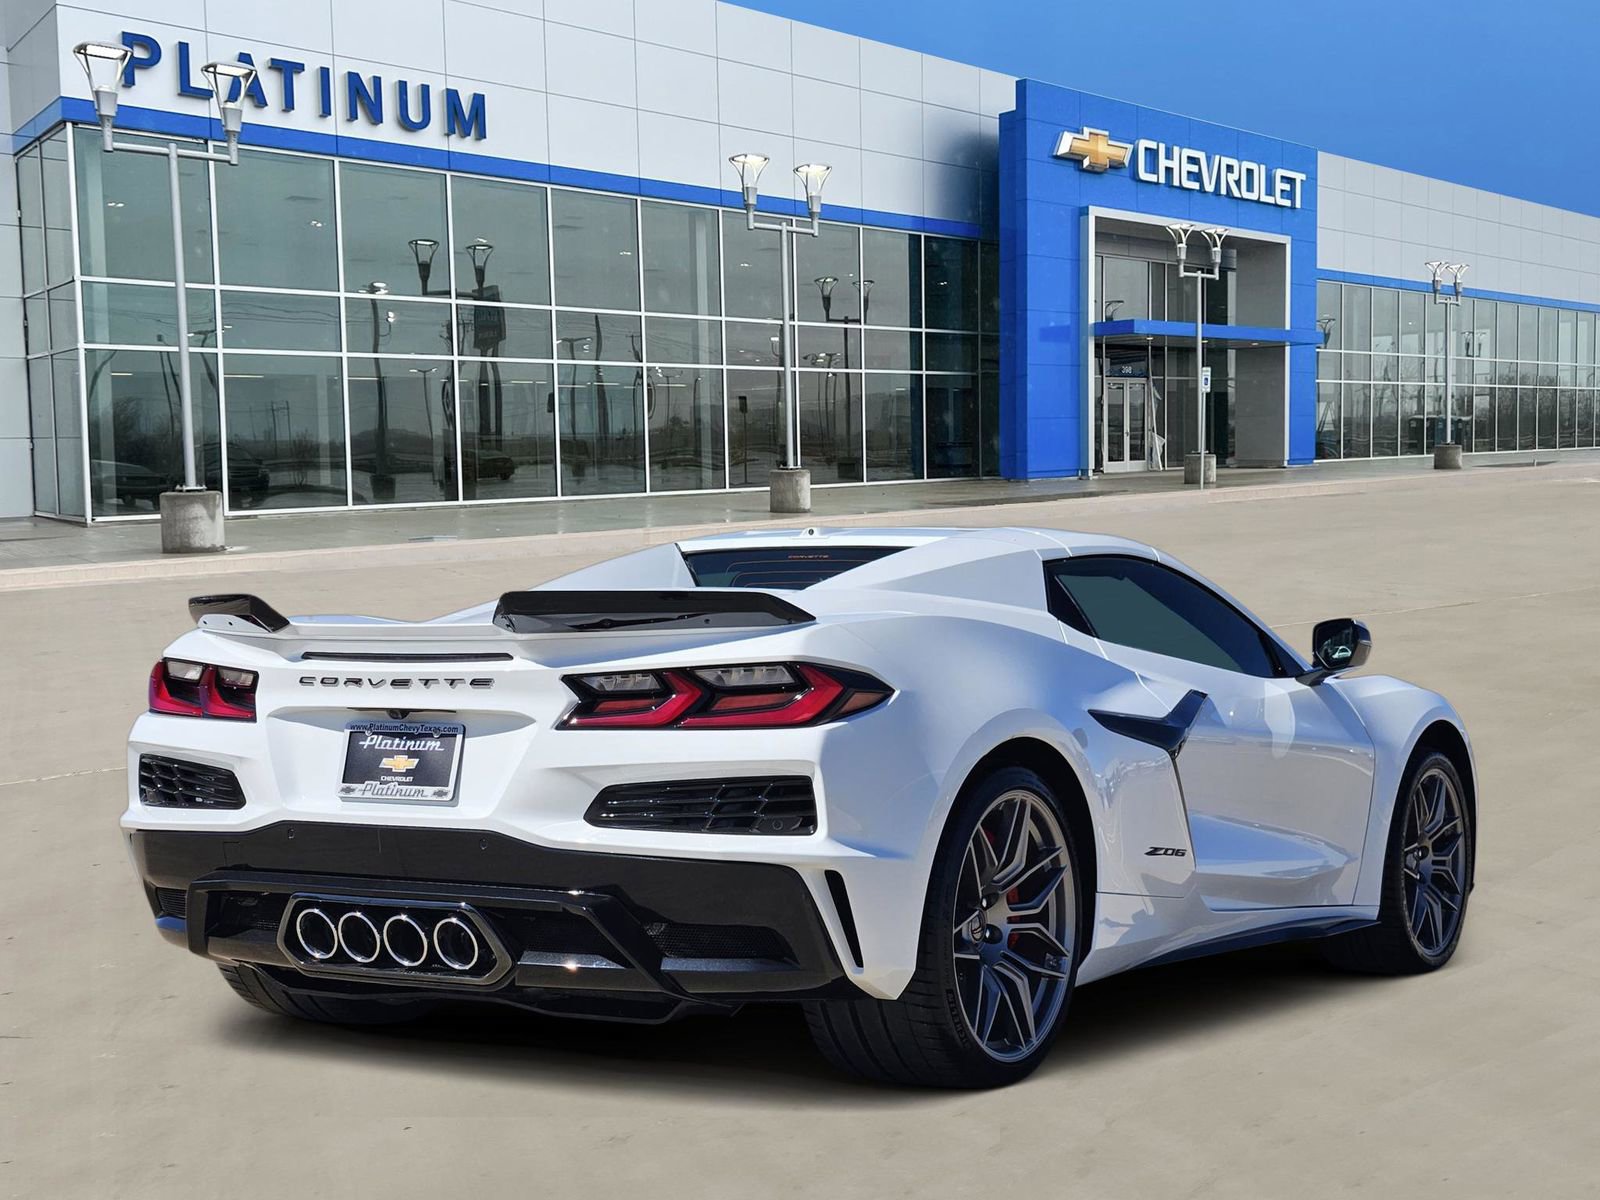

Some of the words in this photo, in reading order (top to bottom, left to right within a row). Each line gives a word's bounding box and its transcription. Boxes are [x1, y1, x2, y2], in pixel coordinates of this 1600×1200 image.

[121, 30, 487, 141] PLATINUM
[1134, 138, 1307, 209] CHEVROLET
[299, 676, 495, 690] CORVETTE
[358, 734, 445, 751] Platinum
[358, 782, 428, 798] Platinum
[1144, 846, 1188, 857] Z06
